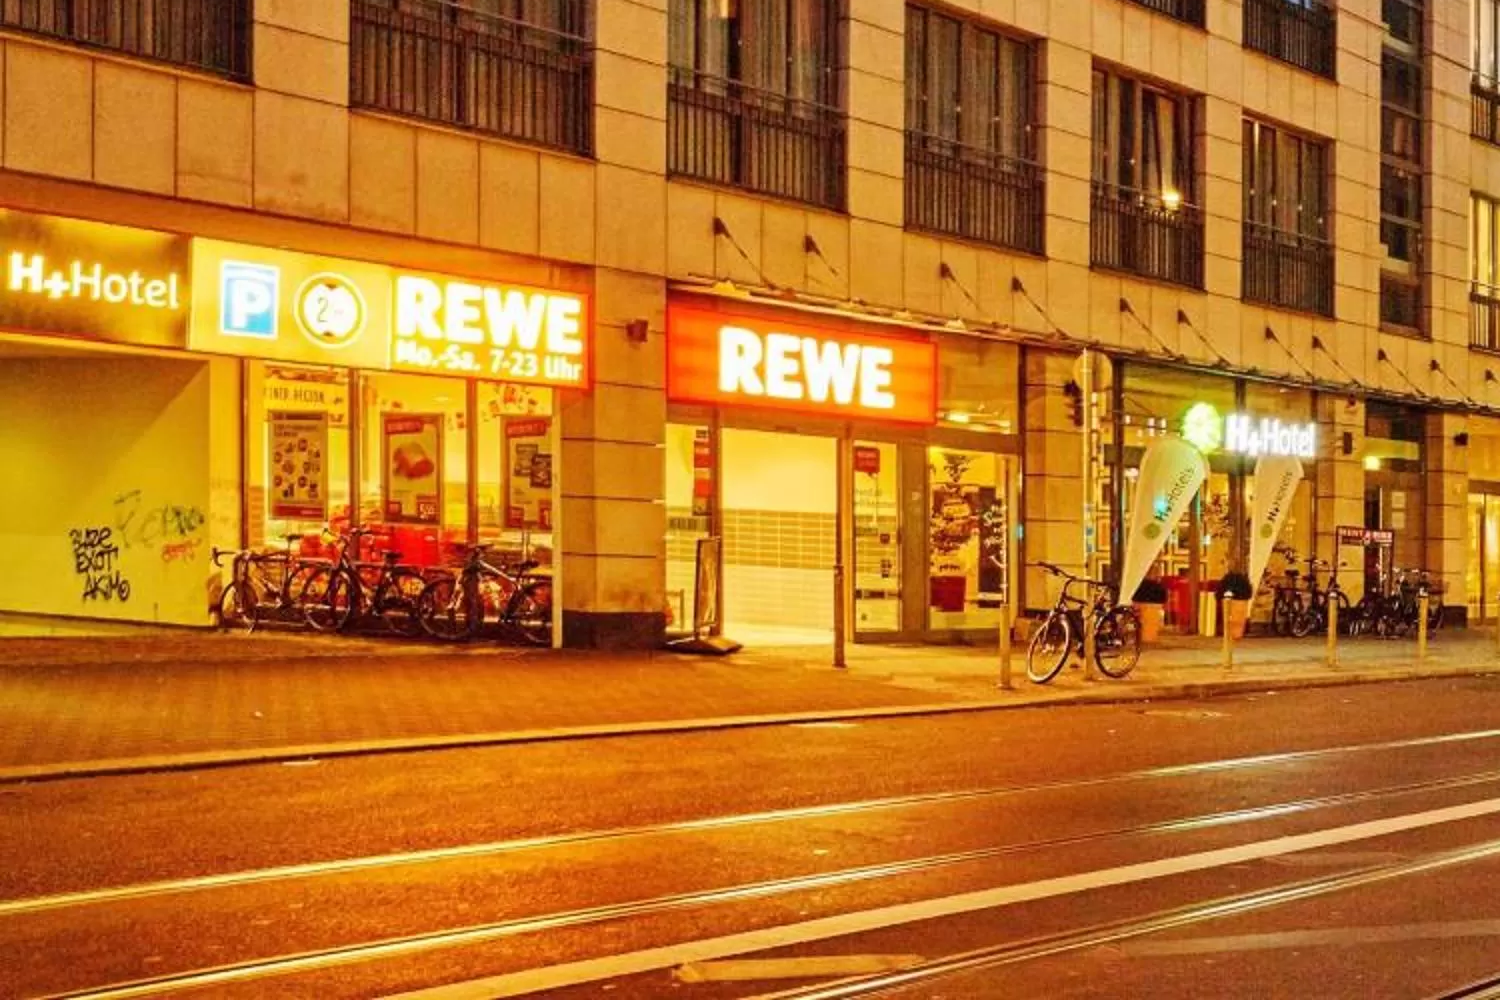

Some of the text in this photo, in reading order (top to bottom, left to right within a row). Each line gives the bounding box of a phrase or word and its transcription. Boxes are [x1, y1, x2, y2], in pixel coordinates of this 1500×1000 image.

[9, 252, 179, 309] H+Hotel
[396, 275, 583, 354] REWE
[543, 353, 582, 381] Uhr
[719, 325, 895, 408] REWE
